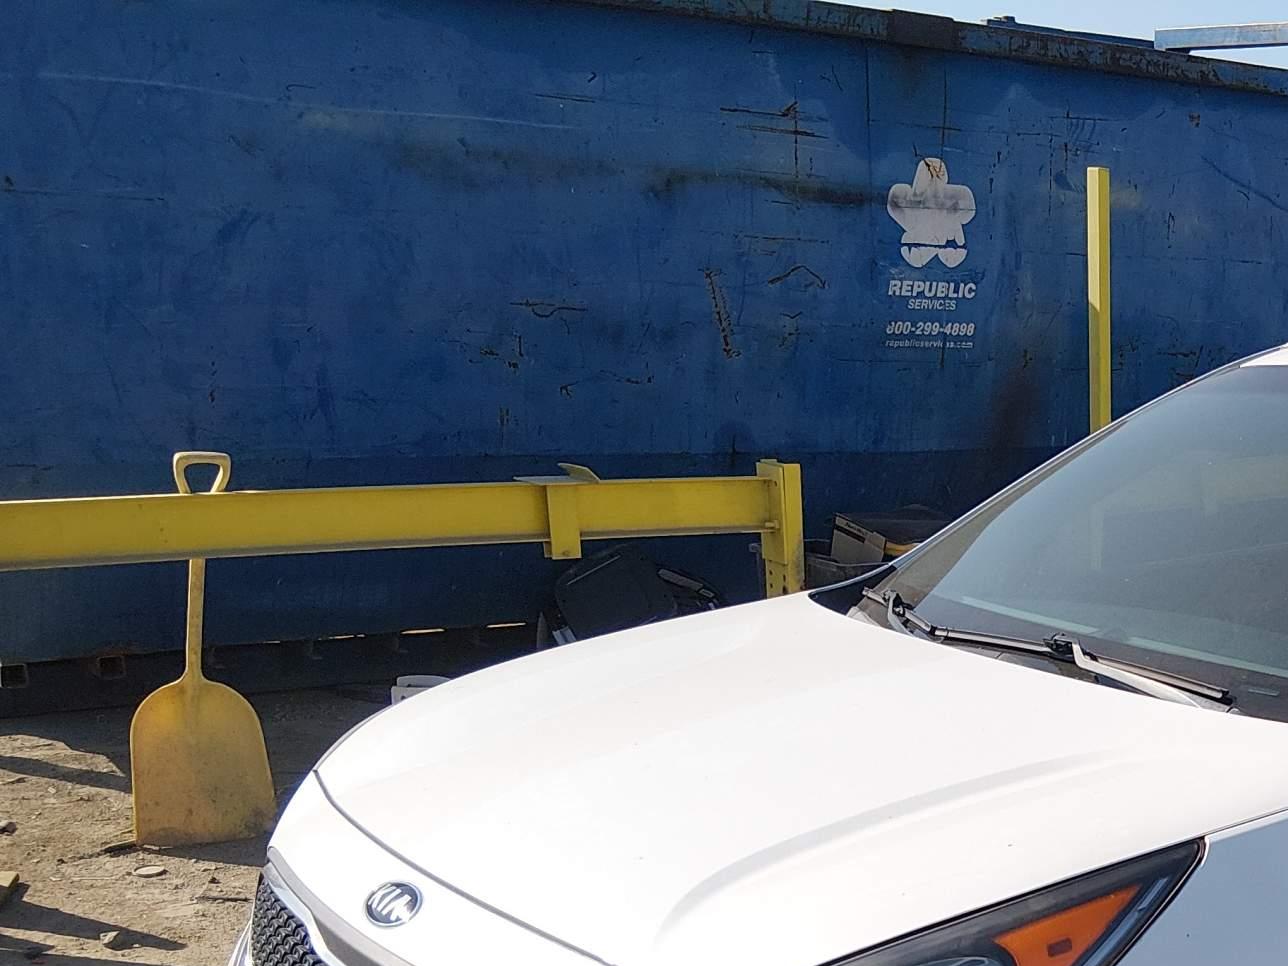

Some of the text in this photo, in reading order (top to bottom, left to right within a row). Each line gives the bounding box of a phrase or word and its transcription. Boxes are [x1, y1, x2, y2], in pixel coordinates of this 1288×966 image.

[887, 280, 977, 299] REPUBLIC
[907, 299, 957, 310] SERVICES
[885, 321, 976, 336] 800-299-4898
